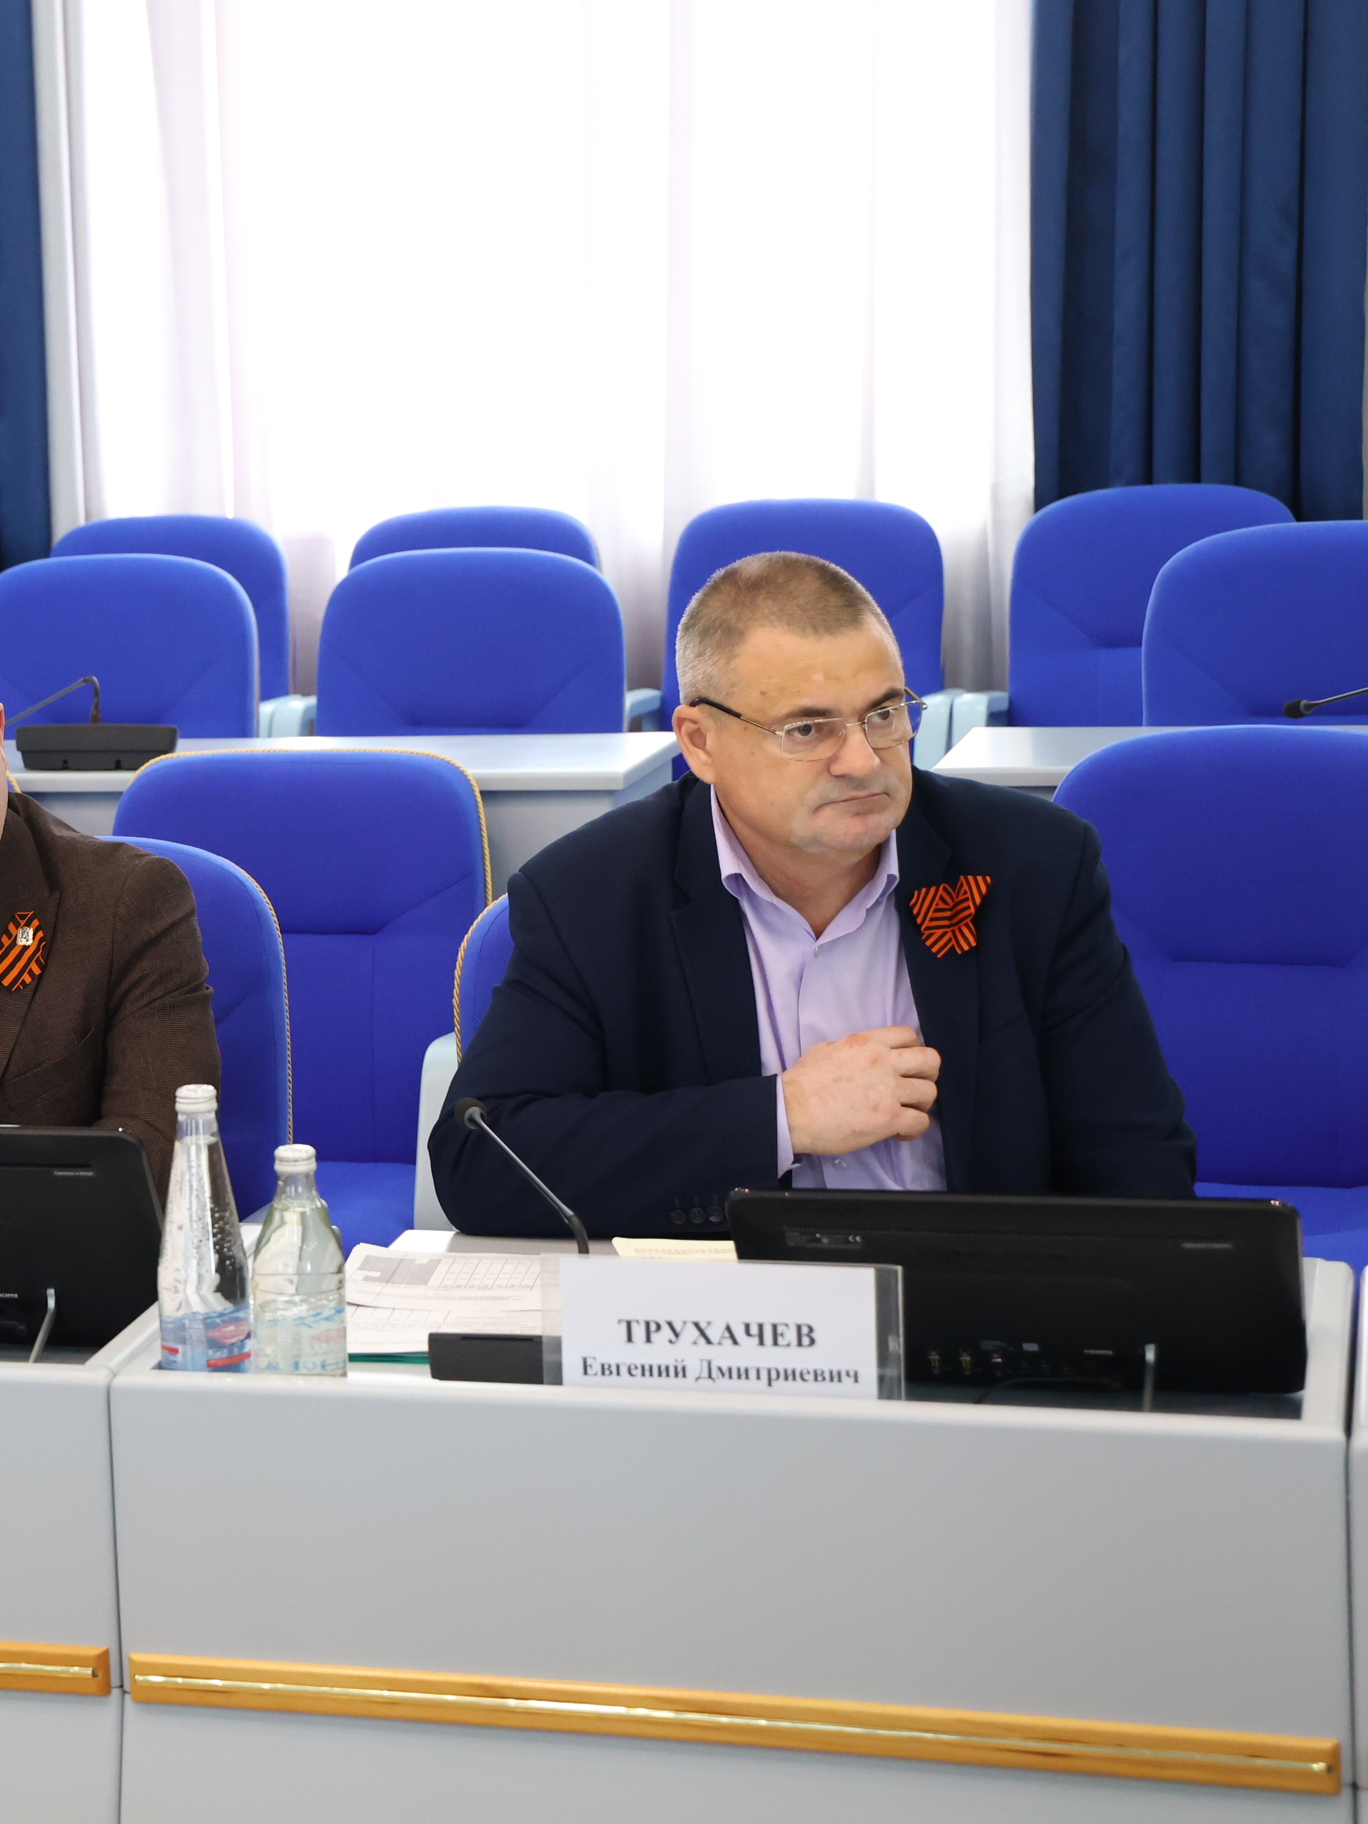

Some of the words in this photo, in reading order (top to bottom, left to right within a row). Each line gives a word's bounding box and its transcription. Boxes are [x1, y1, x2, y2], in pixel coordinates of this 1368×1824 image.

[617, 1318, 817, 1348] ТРУХАЧЕВ
[580, 1355, 688, 1379] Евгений
[694, 1358, 860, 1387] Дмитриевич
